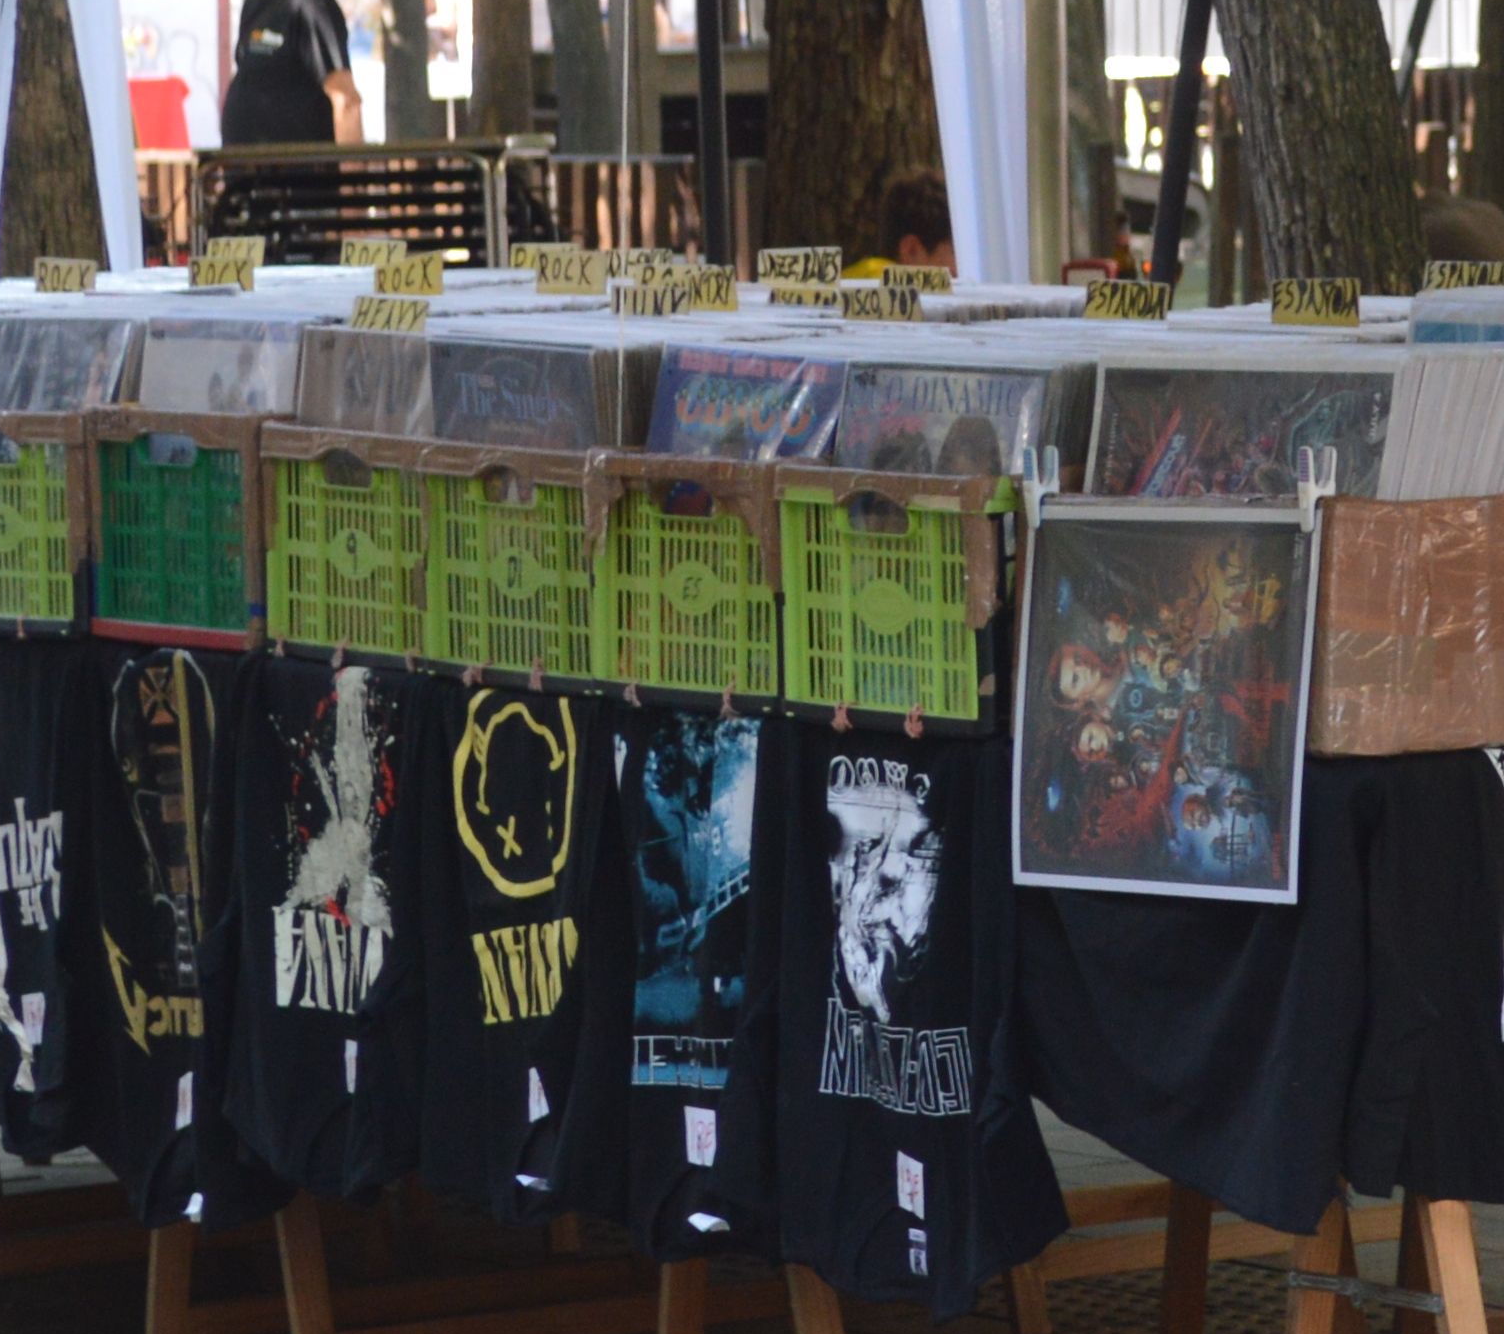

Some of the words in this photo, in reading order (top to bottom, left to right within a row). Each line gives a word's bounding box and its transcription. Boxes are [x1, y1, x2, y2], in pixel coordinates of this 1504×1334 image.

[39, 263, 92, 293] ROCK
[191, 259, 247, 291] ROCK
[378, 255, 433, 294] ROCK
[538, 253, 592, 286] ROCK
[353, 297, 426, 332] HEAVY
